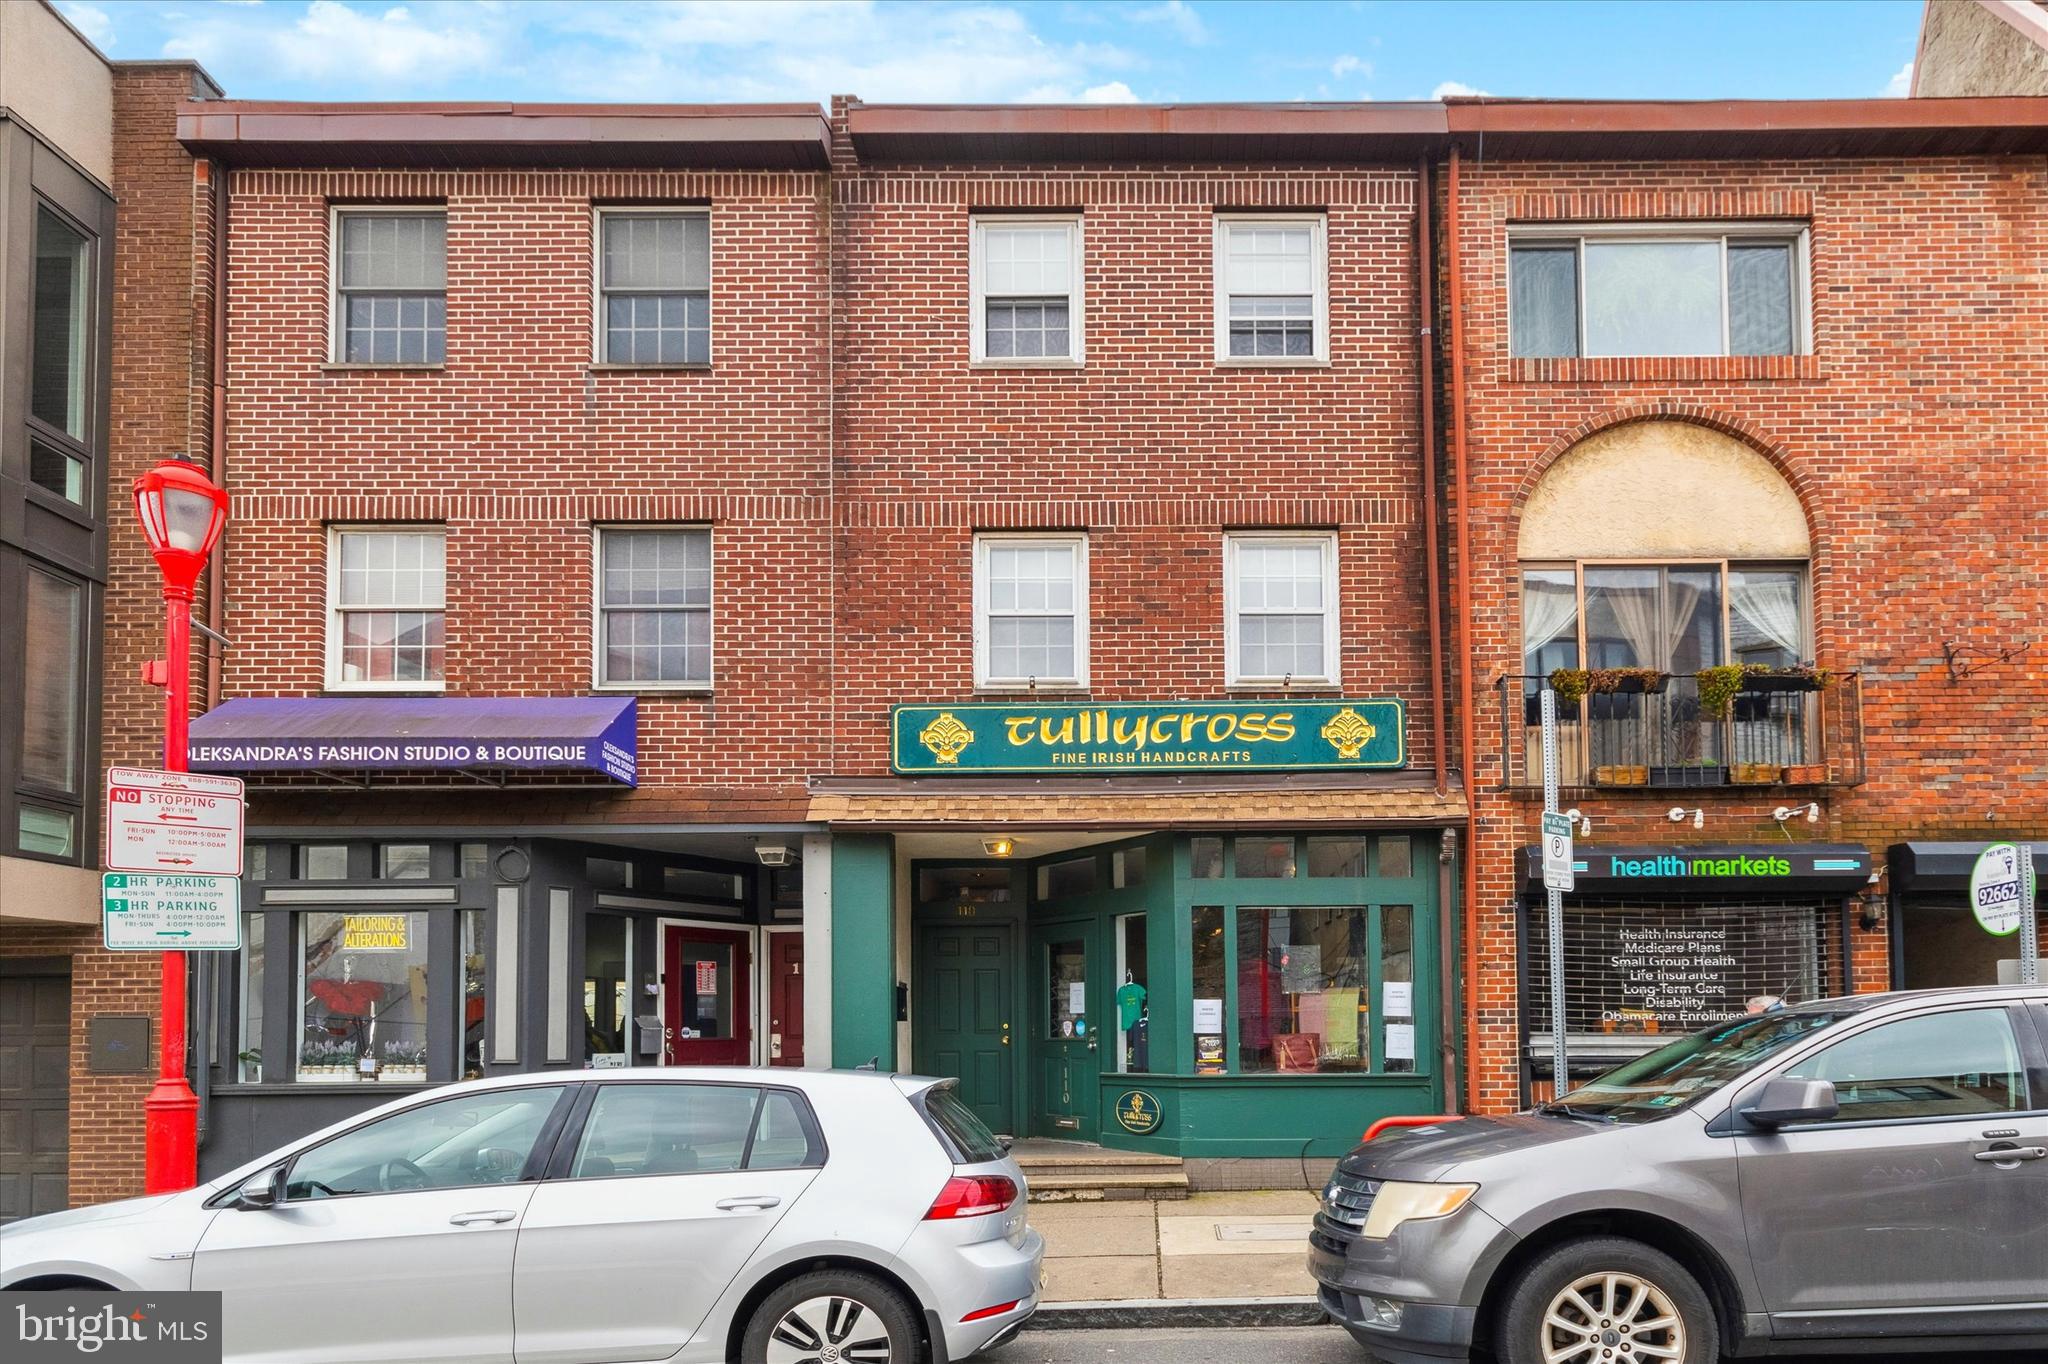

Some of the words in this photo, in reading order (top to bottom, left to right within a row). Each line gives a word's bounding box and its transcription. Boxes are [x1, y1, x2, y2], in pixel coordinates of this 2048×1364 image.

[187, 746, 314, 762] LEKSANDRA'S
[318, 746, 399, 761] FASHION
[403, 746, 471, 761] STUDIO
[476, 746, 489, 761] &
[494, 746, 586, 762] BOUTIQUE
[1052, 752, 1087, 764] FINE
[1091, 752, 1136, 764] IRISH
[1141, 751, 1252, 763] HANDCRAFTS
[602, 750, 621, 766] FASHION
[620, 759, 636, 774] STUDIO
[116, 790, 138, 803] NO
[148, 793, 216, 809] STOPPING
[127, 827, 156, 835] FRI-SUN
[1997, 847, 2011, 856] WITH
[1692, 855, 1791, 877] markets
[113, 876, 121, 886] 2
[130, 877, 148, 887] HR
[156, 877, 217, 888] PARKING
[1979, 882, 2019, 905] 92662
[113, 900, 122, 910] 3
[131, 900, 149, 911] HR
[157, 901, 218, 911] PARKING
[343, 917, 396, 931] TAILORING
[396, 917, 406, 931] &
[343, 932, 406, 947] ALTERATIONS
[1619, 928, 1661, 940] Health
[1665, 928, 1726, 940] Insurance
[1625, 942, 1684, 953] Medicare
[1688, 942, 1721, 953] Plans
[792, 962, 800, 975] 1
[1611, 956, 1645, 967] Small
[1649, 956, 1689, 969] Group
[1694, 955, 1736, 966] Health
[1630, 969, 1653, 980] Life
[1624, 983, 1692, 996] Long-Term
[1695, 983, 1726, 994] Care
[1646, 997, 1705, 1010] Disability
[1602, 1010, 1676, 1022] Obamacare
